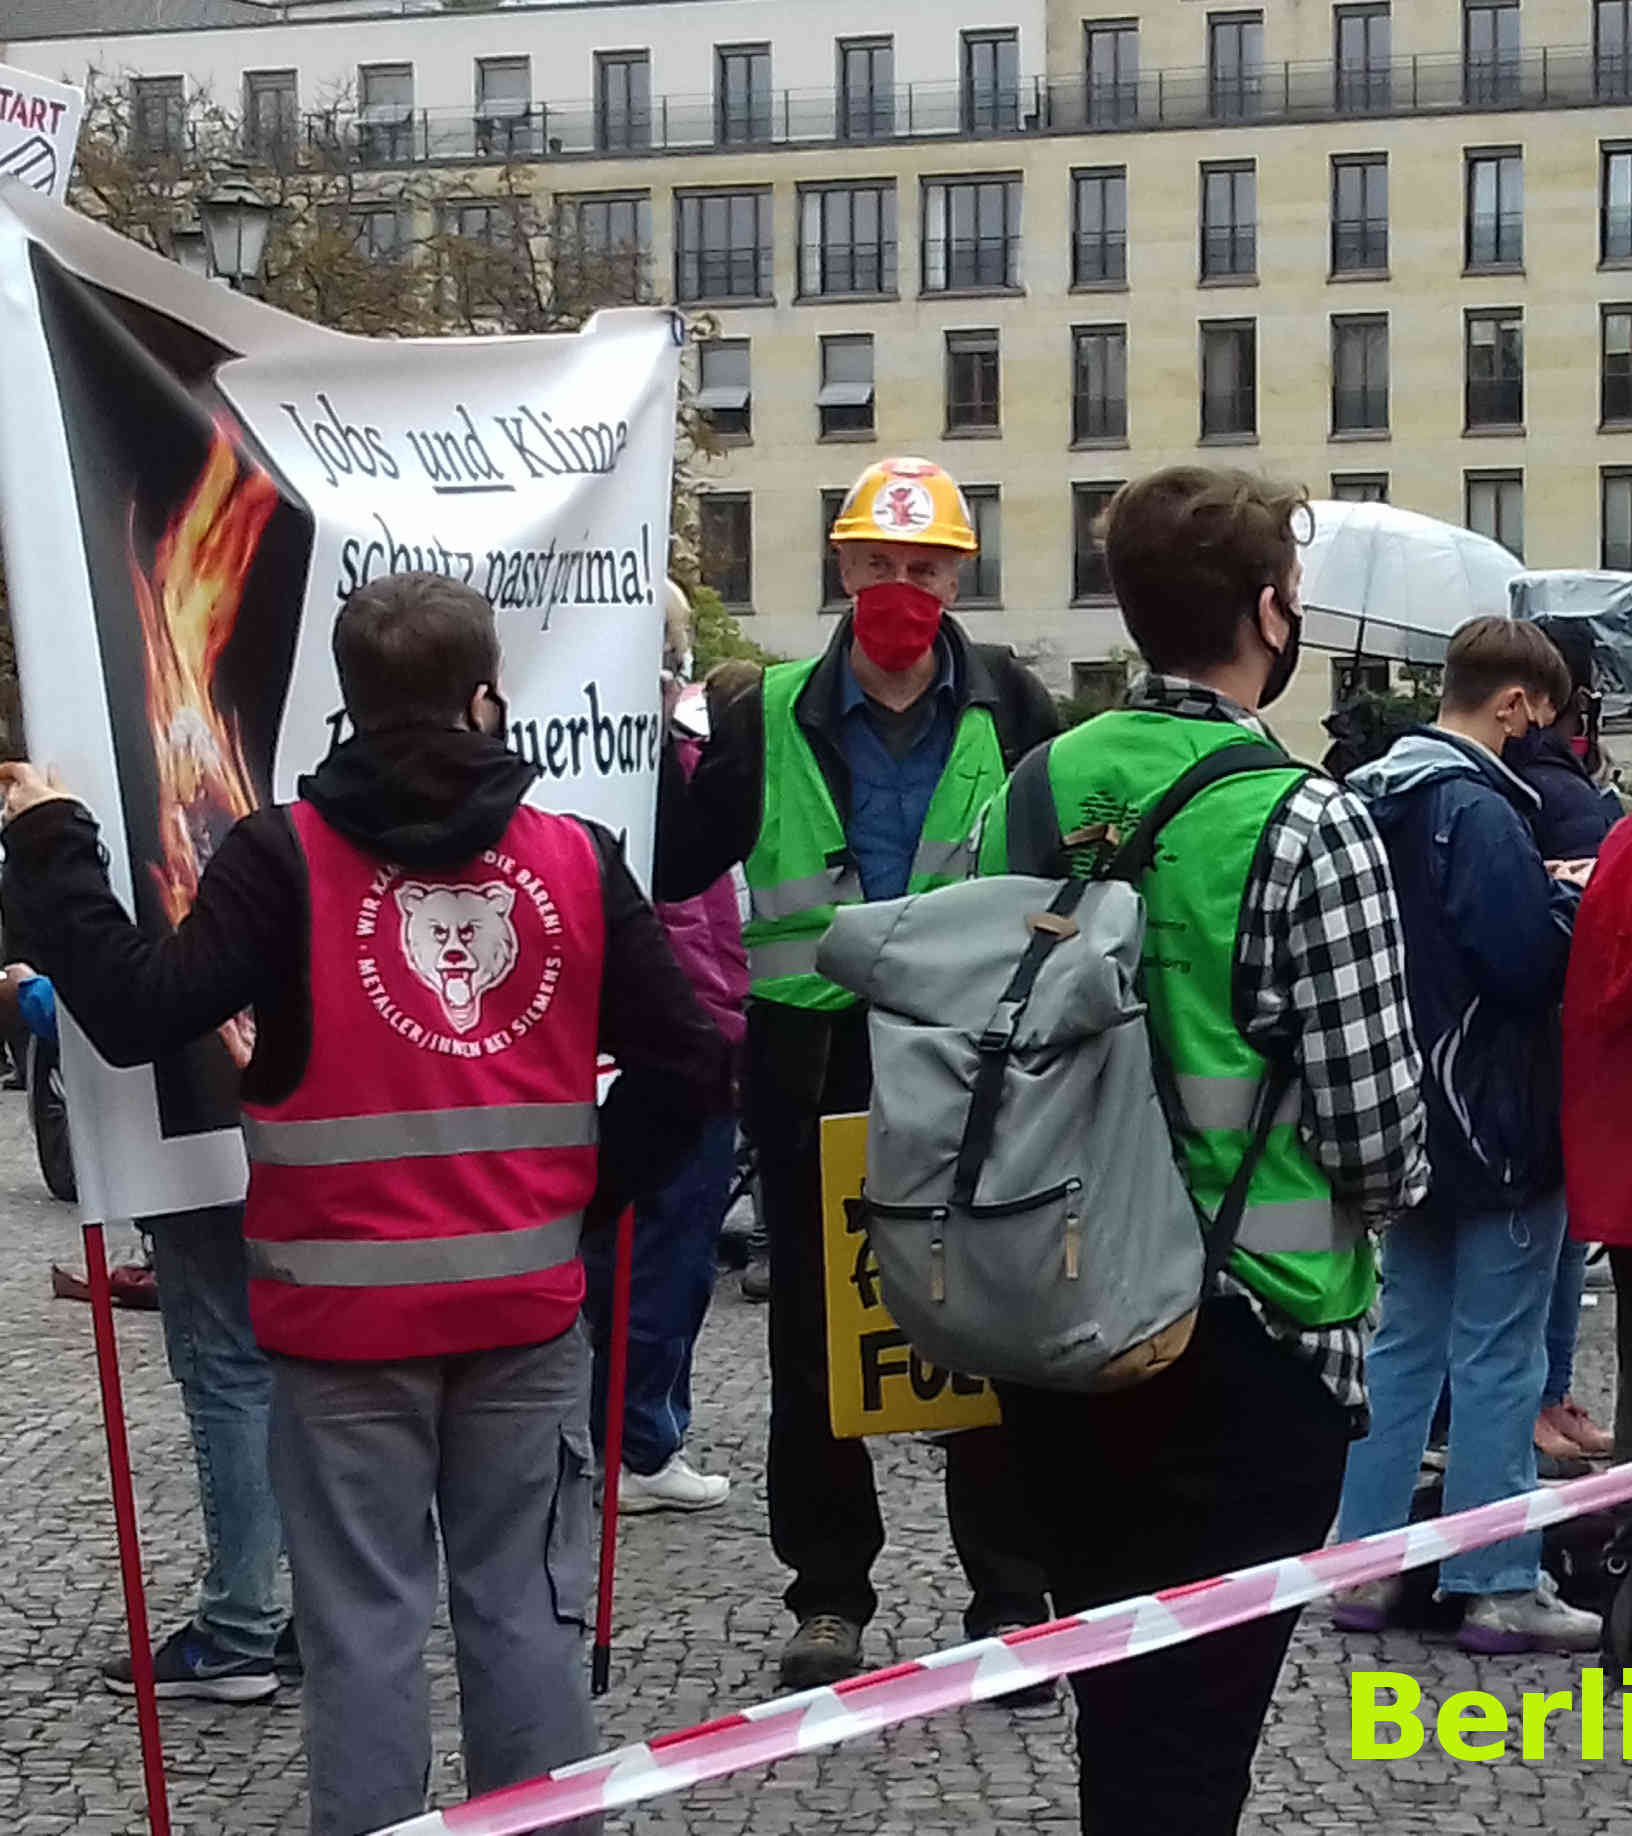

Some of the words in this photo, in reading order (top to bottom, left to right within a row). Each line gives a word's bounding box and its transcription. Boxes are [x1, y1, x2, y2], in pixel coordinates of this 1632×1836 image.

[279, 393, 401, 487] Jobs
[407, 404, 504, 482] und
[495, 405, 627, 475] Klima
[486, 536, 556, 609] passt
[542, 523, 653, 631] prima!
[356, 897, 382, 937] WIR
[483, 850, 516, 875] DIE
[515, 869, 563, 936] BÄREN!
[357, 957, 482, 1058] METALLER/INNEN
[511, 957, 562, 1036] SIEMENS
